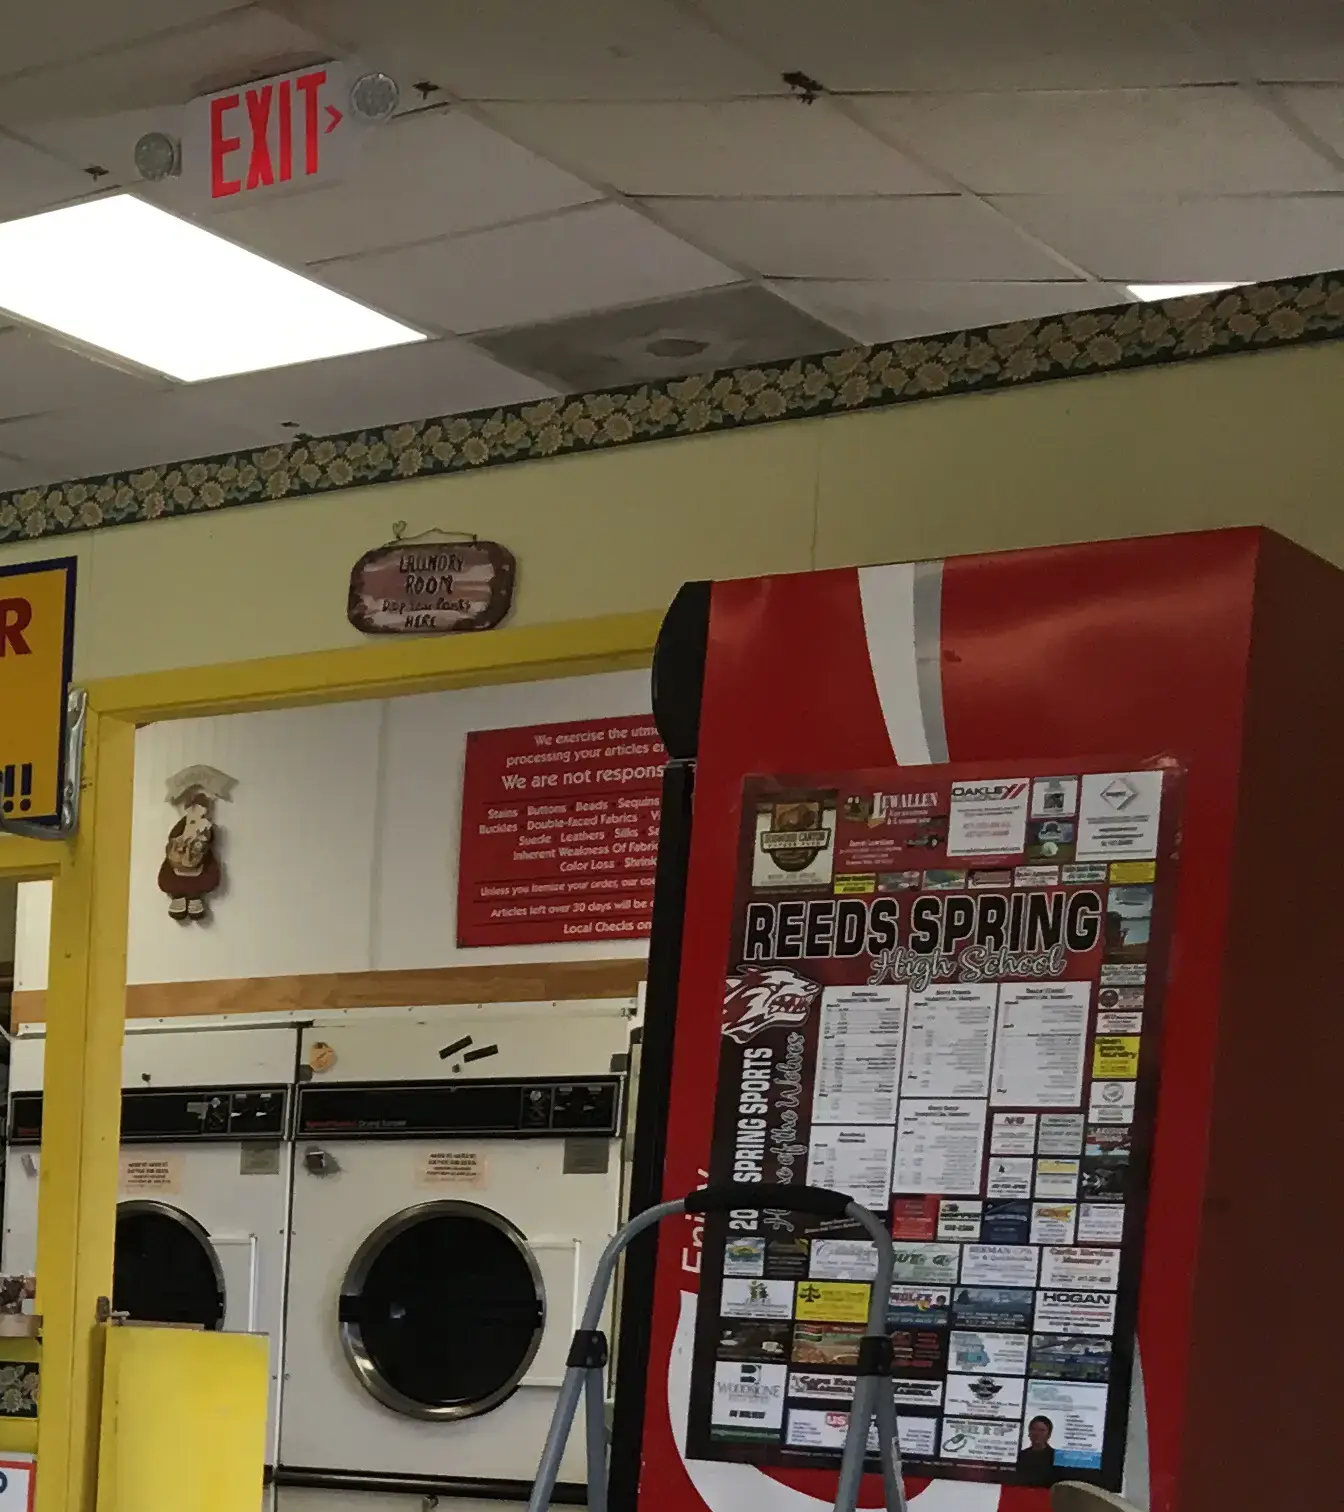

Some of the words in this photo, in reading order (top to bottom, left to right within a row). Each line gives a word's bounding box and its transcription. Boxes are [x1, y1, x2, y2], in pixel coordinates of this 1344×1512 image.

[210, 70, 327, 199] EXIT
[405, 574, 454, 595] ROOM
[534, 735, 552, 746] We
[556, 731, 604, 744] exercise
[608, 728, 628, 739] the
[506, 749, 570, 767] processing
[573, 747, 602, 761] your
[605, 743, 649, 757] articles
[502, 774, 526, 790] We
[531, 775, 558, 788] are
[564, 770, 592, 785] not
[596, 765, 665, 783] respons
[952, 785, 1018, 797] OAKLEY
[600, 813, 638, 825] Fabrics
[612, 842, 627, 853] Of
[560, 860, 588, 872] Color
[591, 859, 615, 870] Loss
[567, 881, 588, 892] your
[573, 902, 586, 912] 30
[563, 922, 592, 934] Local
[595, 920, 634, 933] Checks
[743, 898, 899, 960] REEDS
[910, 890, 1103, 956] SPRING
[867, 946, 957, 992] High
[960, 943, 1068, 983] School
[739, 1047, 773, 1114] SPORTS
[774, 1031, 806, 1108] Wolves
[770, 1109, 800, 1144] the
[733, 1118, 768, 1183] SPRING
[770, 1142, 808, 1166] of
[1043, 1292, 1111, 1305] HOGAN
